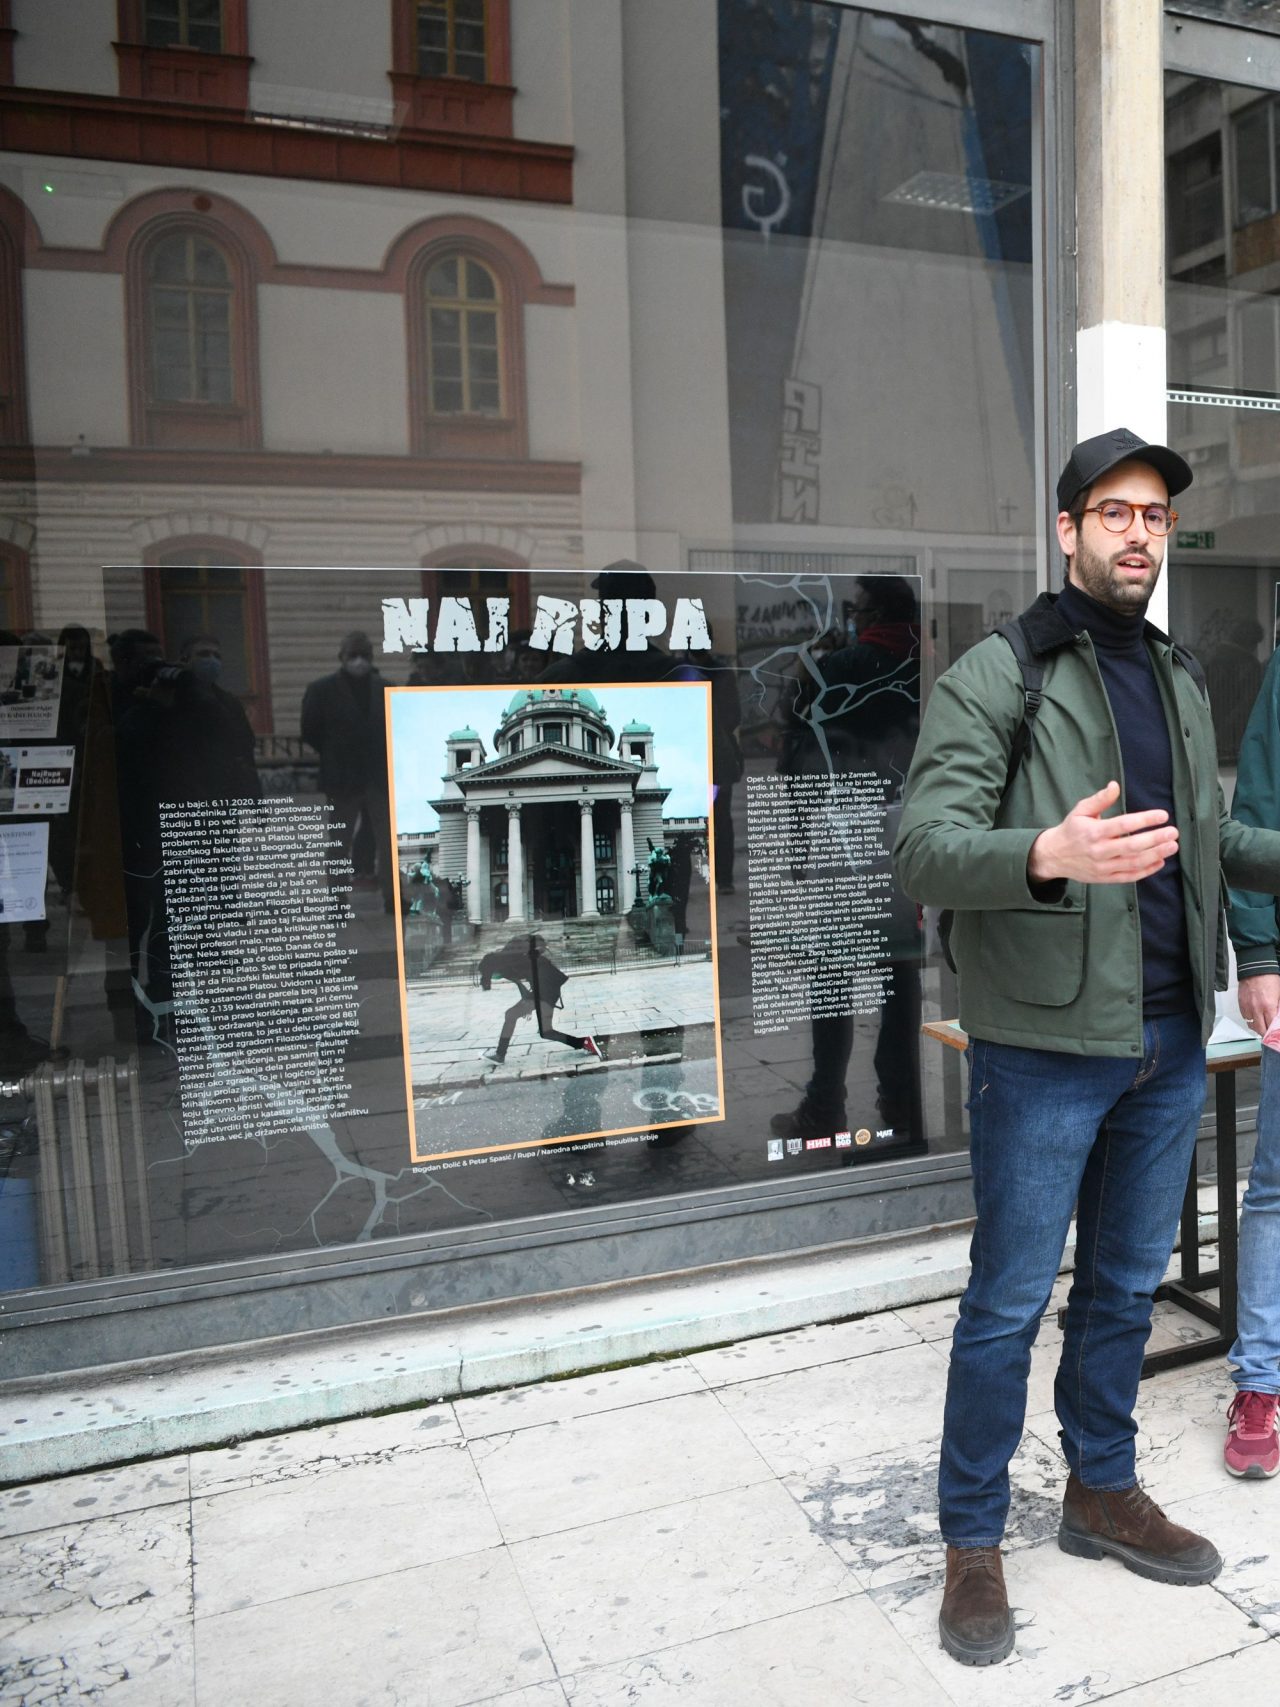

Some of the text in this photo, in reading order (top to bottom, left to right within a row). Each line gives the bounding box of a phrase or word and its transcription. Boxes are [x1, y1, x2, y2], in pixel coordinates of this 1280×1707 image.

[381, 596, 510, 653] NAJ
[528, 595, 712, 655] RUPA
[159, 809, 227, 820] gradonačelnika
[228, 806, 272, 817] (Zamenik)
[273, 806, 312, 814] gostovao
[312, 804, 321, 813] je
[159, 819, 192, 828] Studiju
[220, 817, 236, 825] već
[238, 816, 286, 824] ustaljenom
[288, 814, 322, 822] obrascu
[160, 830, 207, 838] odgovarao
[221, 826, 263, 834] naručena
[297, 823, 325, 831] Ovoga
[326, 822, 346, 830] puta
[160, 847, 211, 856] Filozofskog
[212, 845, 251, 853] fakulteta
[305, 839, 342, 848] Zamenik
[161, 839, 200, 848] problem
[213, 836, 230, 844] bile
[296, 831, 323, 841] ispred
[183, 856, 220, 866] prilikom
[168, 941, 198, 952] njihovi
[199, 938, 238, 949] profesori
[265, 935, 287, 943] malo
[301, 932, 325, 940] nešto
[196, 949, 219, 958] Neka
[221, 947, 245, 956] srede
[246, 946, 258, 954] taj
[171, 967, 341, 988] Istina je da Filozofski fakultet nikada nije
[172, 988, 203, 997] izvodio
[205, 986, 235, 994] radove
[280, 979, 313, 987] Uvidom
[322, 975, 355, 983] katastar
[189, 1042, 215, 1051] nalazi
[216, 1040, 234, 1050] pod
[235, 1038, 273, 1048] zgradom
[274, 1032, 322, 1043] Filozofskog
[179, 1072, 215, 1081] obavezu
[217, 1065, 264, 1077] održavanja
[264, 1063, 283, 1071] dela
[284, 1060, 315, 1070] parcele
[316, 1057, 332, 1066] koji
[180, 1089, 212, 1101] pitanju
[213, 1087, 240, 1097] prolaz
[241, 1083, 257, 1092] koji
[258, 1081, 281, 1091] spaja
[282, 1079, 310, 1087] Vasinu
[322, 1075, 343, 1083] Knez
[182, 1109, 201, 1118] koju
[202, 1106, 235, 1115] dnevno
[236, 1101, 263, 1111] koristi
[264, 1098, 286, 1108] veliki
[287, 1096, 304, 1105] broj
[227, 1131, 243, 1140] već
[243, 1131, 252, 1139] je
[253, 1127, 288, 1137] državno
[806, 1138, 832, 1150] НИН
[412, 1164, 441, 1174] Bogdan
[469, 1157, 488, 1166] Petar
[489, 1154, 512, 1163] Spasić
[517, 1150, 536, 1160] Rupa
[541, 1146, 571, 1156] Narodna
[571, 1141, 604, 1154] skupština
[605, 1136, 638, 1146] Republike
[639, 1133, 659, 1143] Srbije
